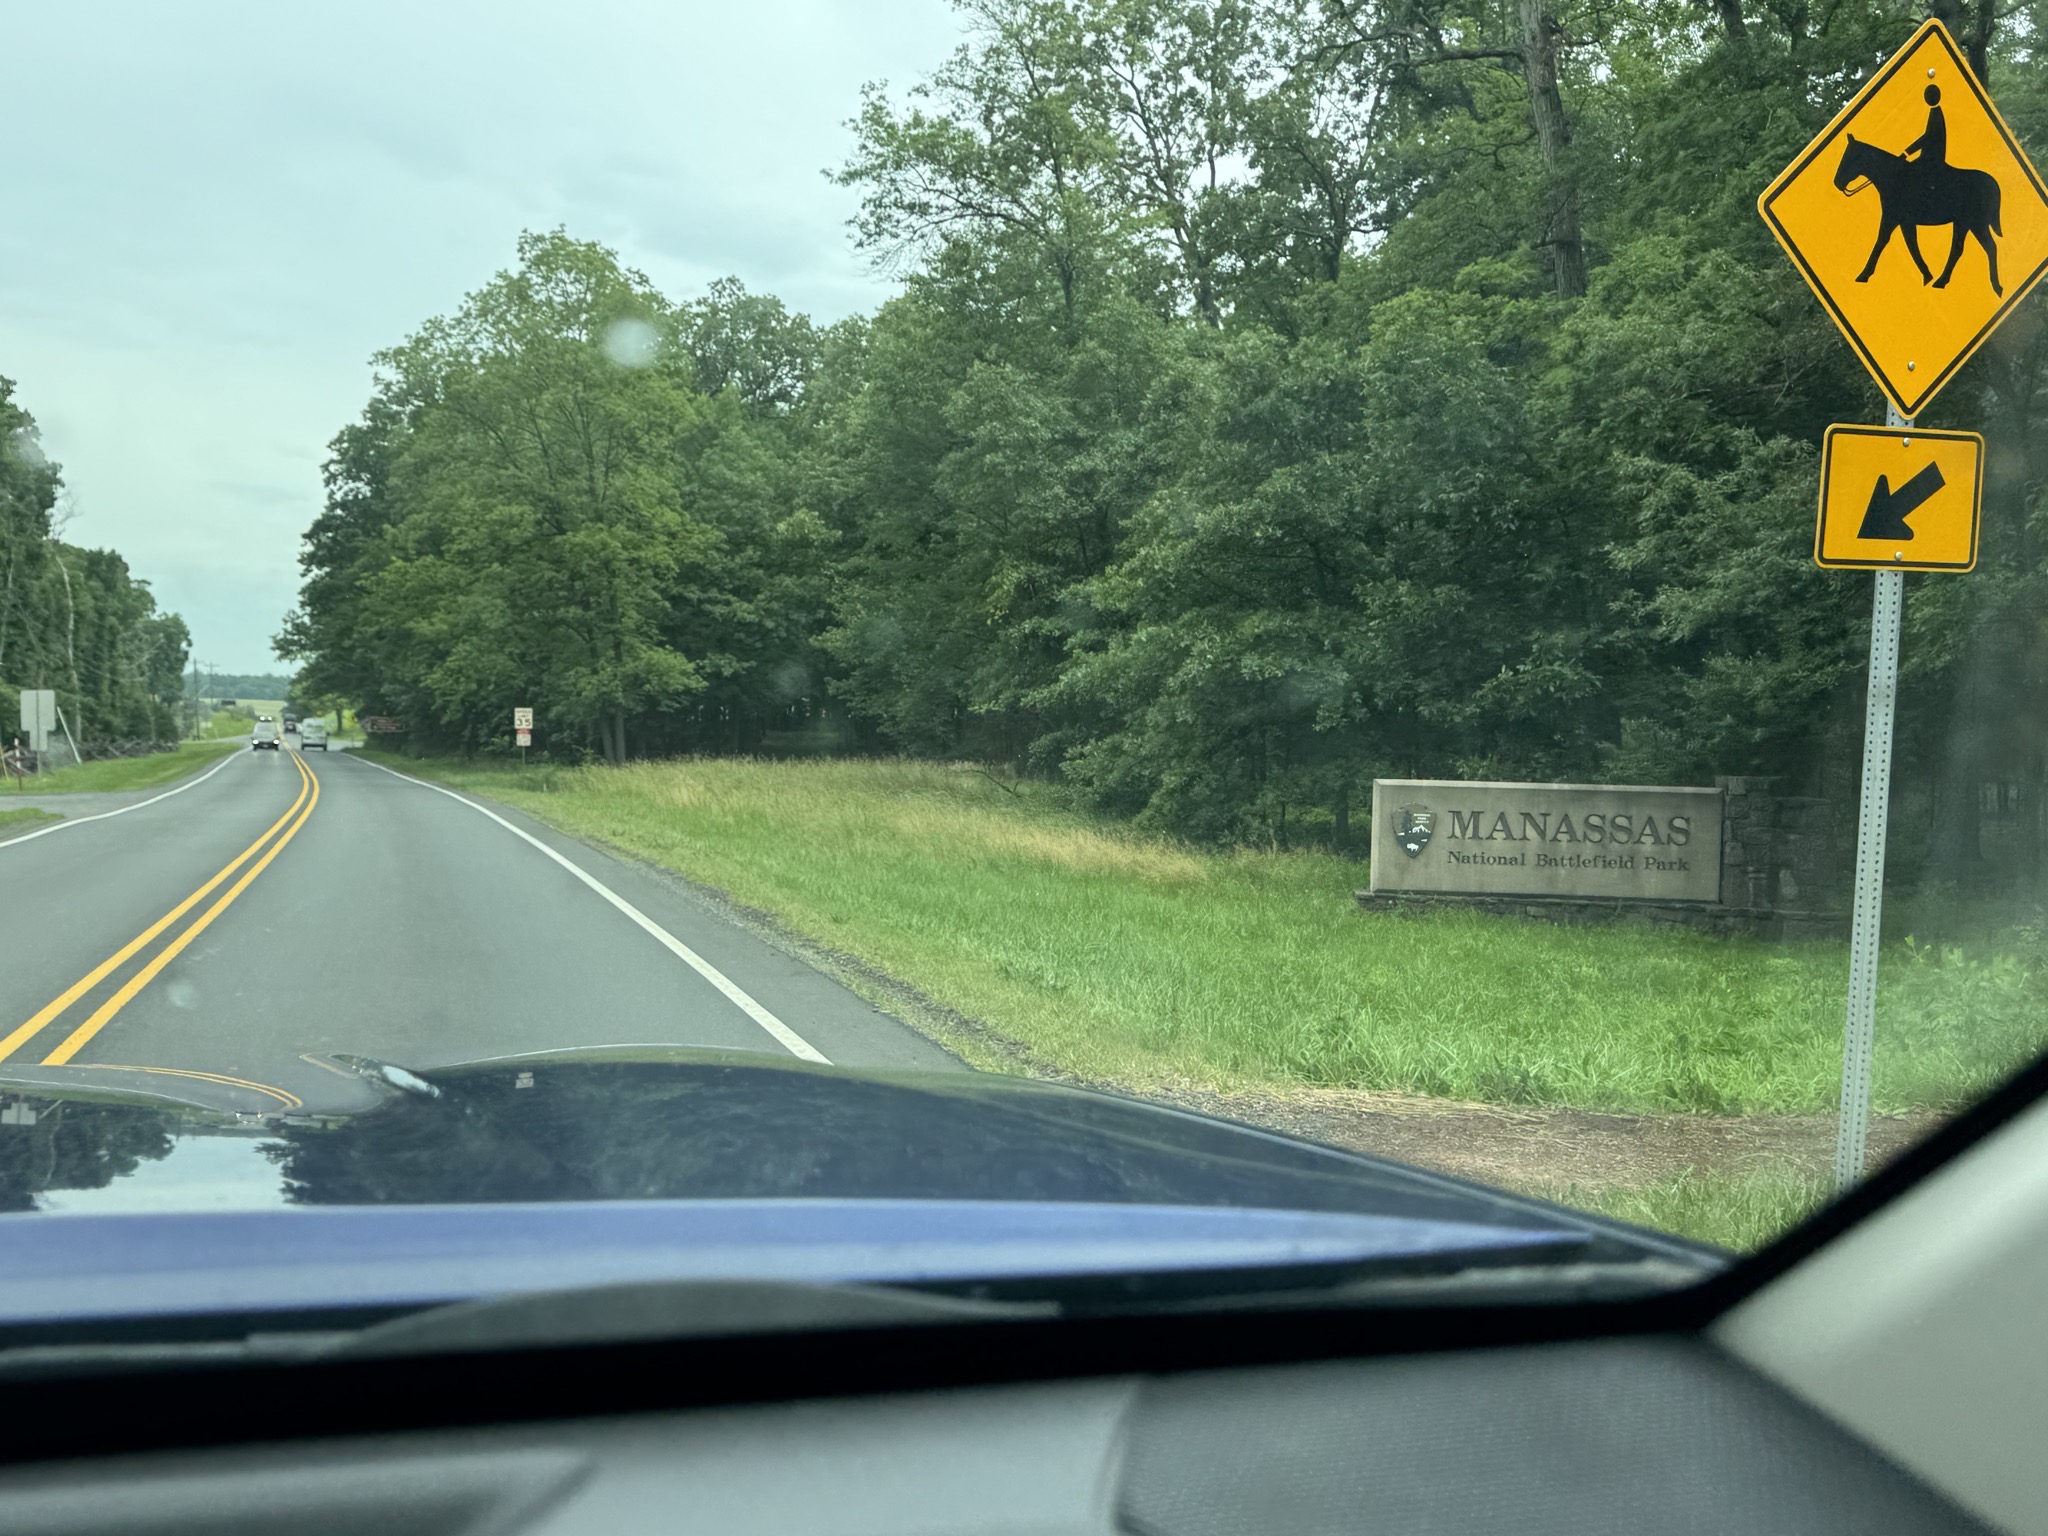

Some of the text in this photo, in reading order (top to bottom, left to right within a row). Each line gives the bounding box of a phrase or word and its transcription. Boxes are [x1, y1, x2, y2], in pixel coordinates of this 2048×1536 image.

[516, 717, 531, 727] 35
[1447, 810, 1691, 846] MANASSAS
[1447, 851, 1690, 871] National Battlefield Park
